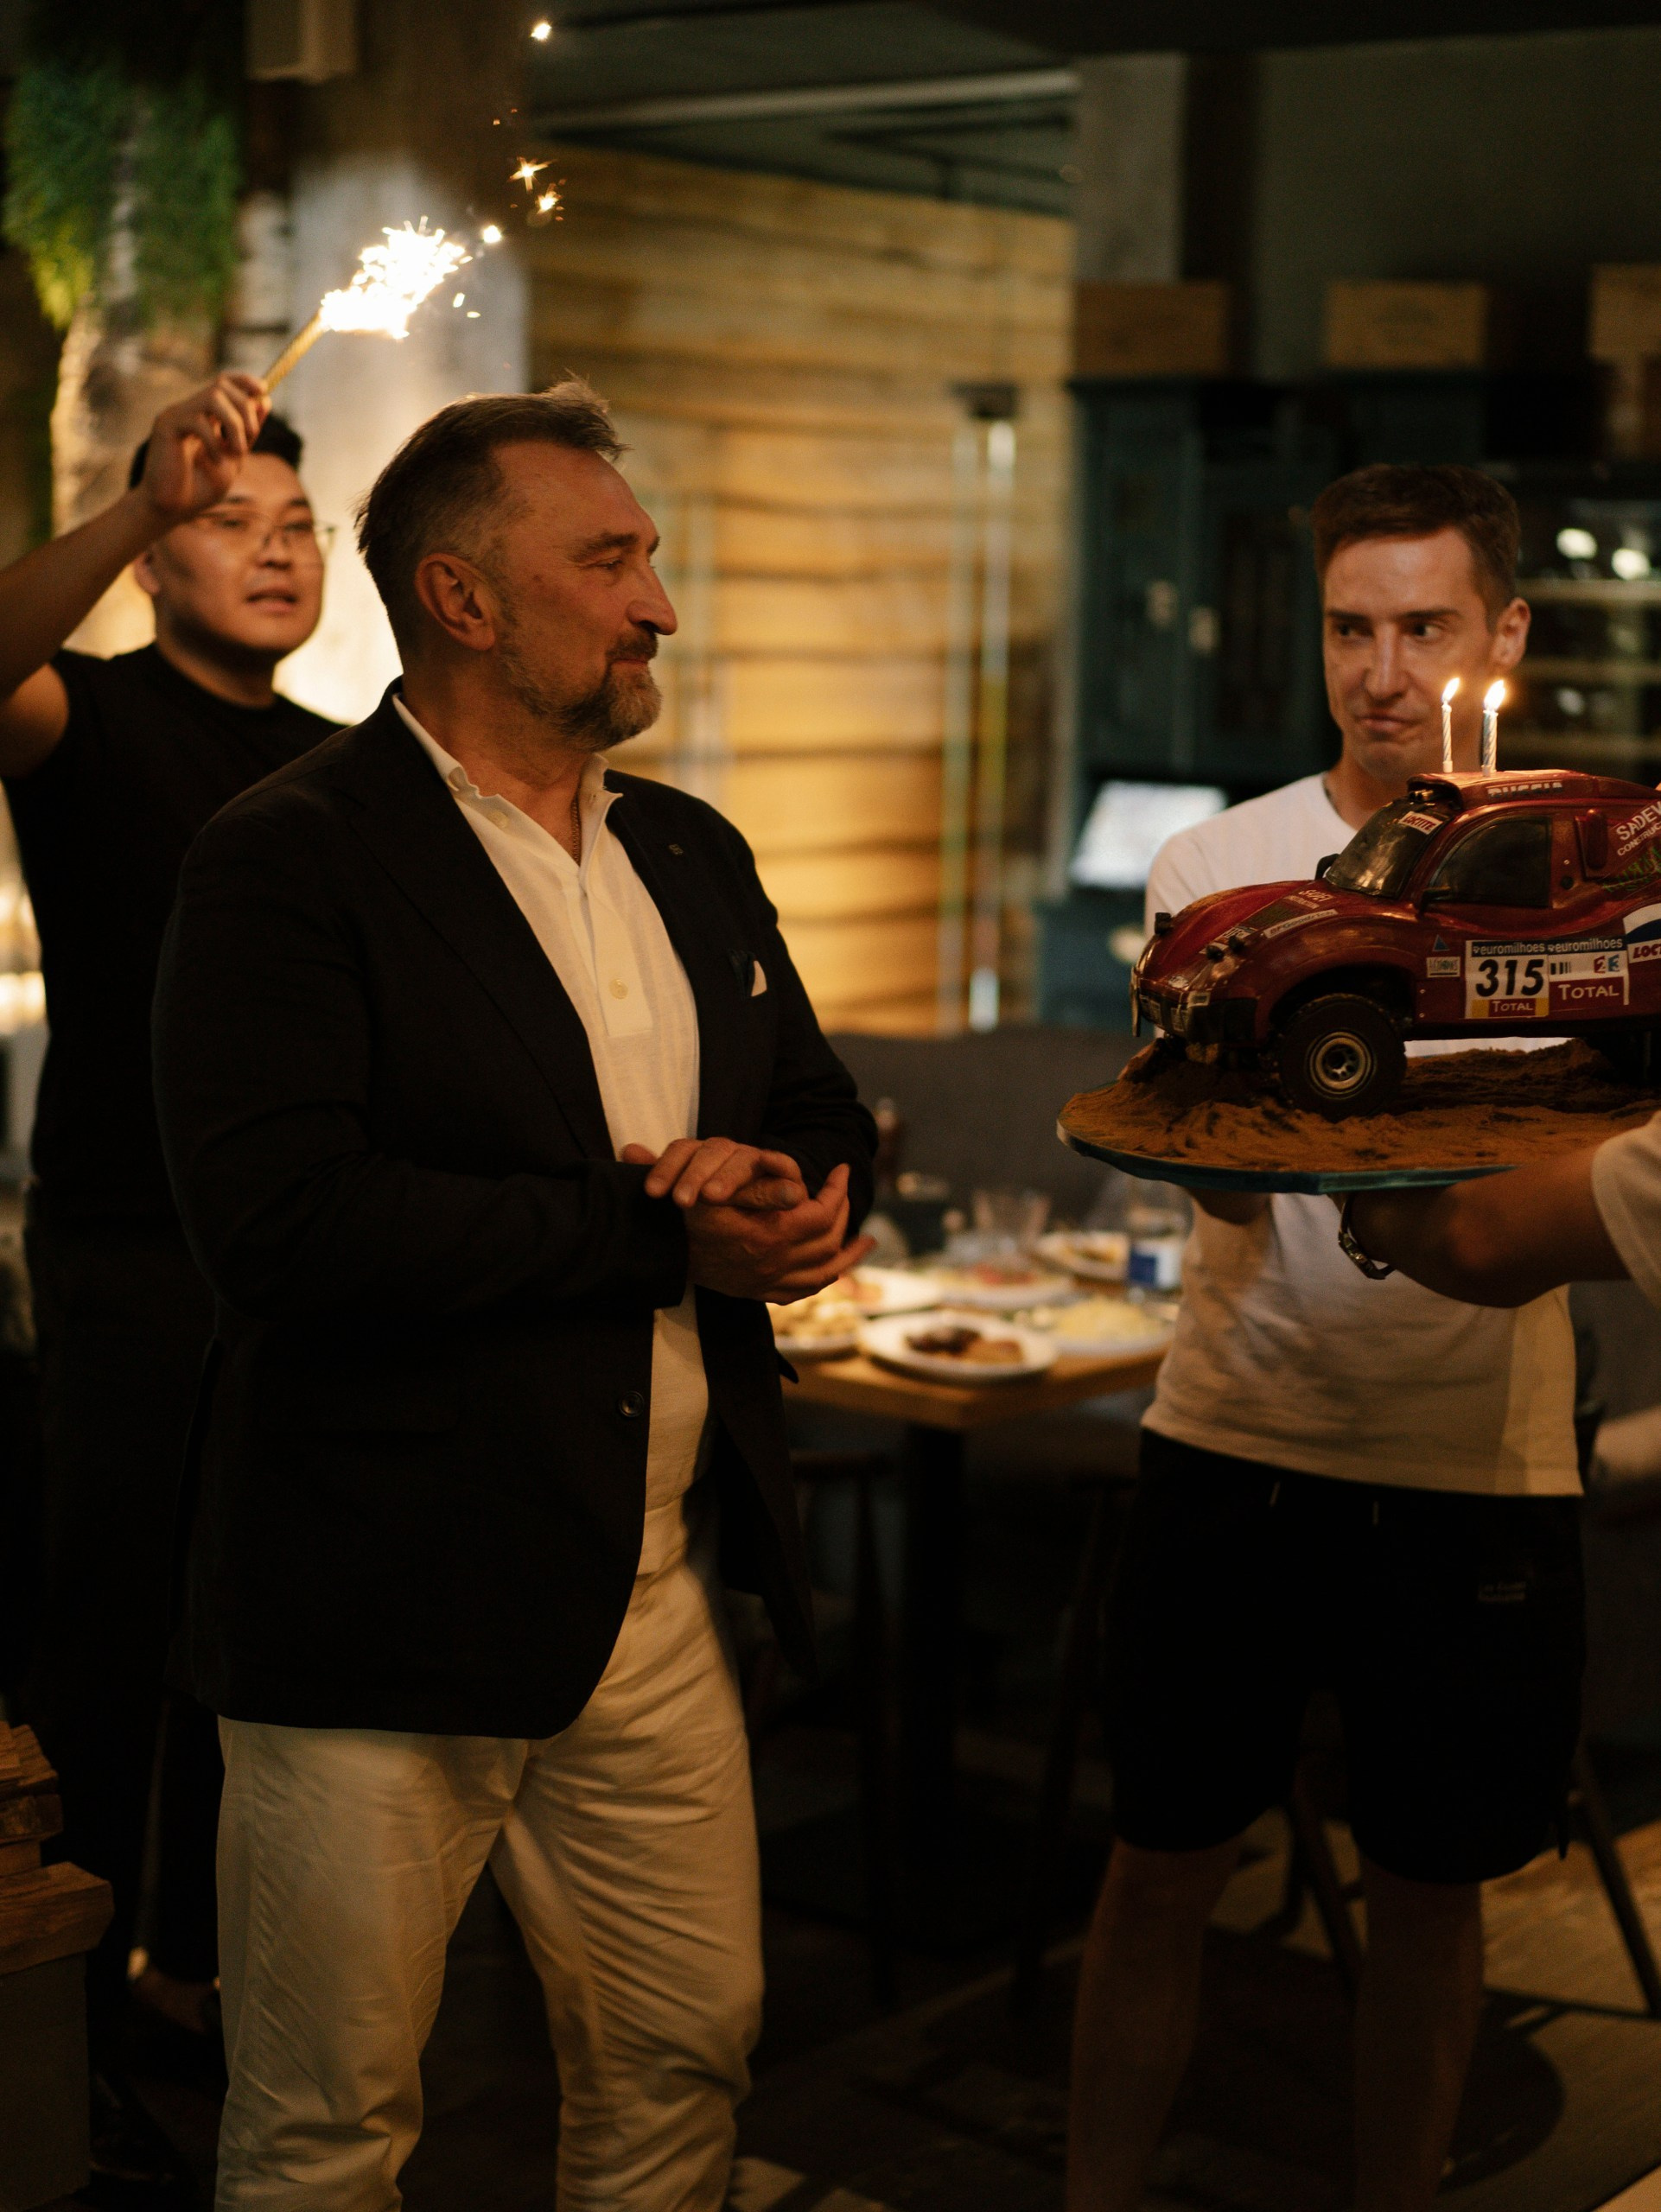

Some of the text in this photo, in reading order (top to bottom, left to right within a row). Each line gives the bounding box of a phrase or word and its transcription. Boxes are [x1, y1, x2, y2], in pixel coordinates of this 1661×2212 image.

[1480, 941, 1545, 957] euromilhoes
[1555, 938, 1623, 953] euromilhoes
[1632, 943, 1661, 959] LOC
[1475, 958, 1545, 997] 315
[1557, 983, 1620, 1001] TOTAL
[1492, 1000, 1535, 1013] TOTAL
